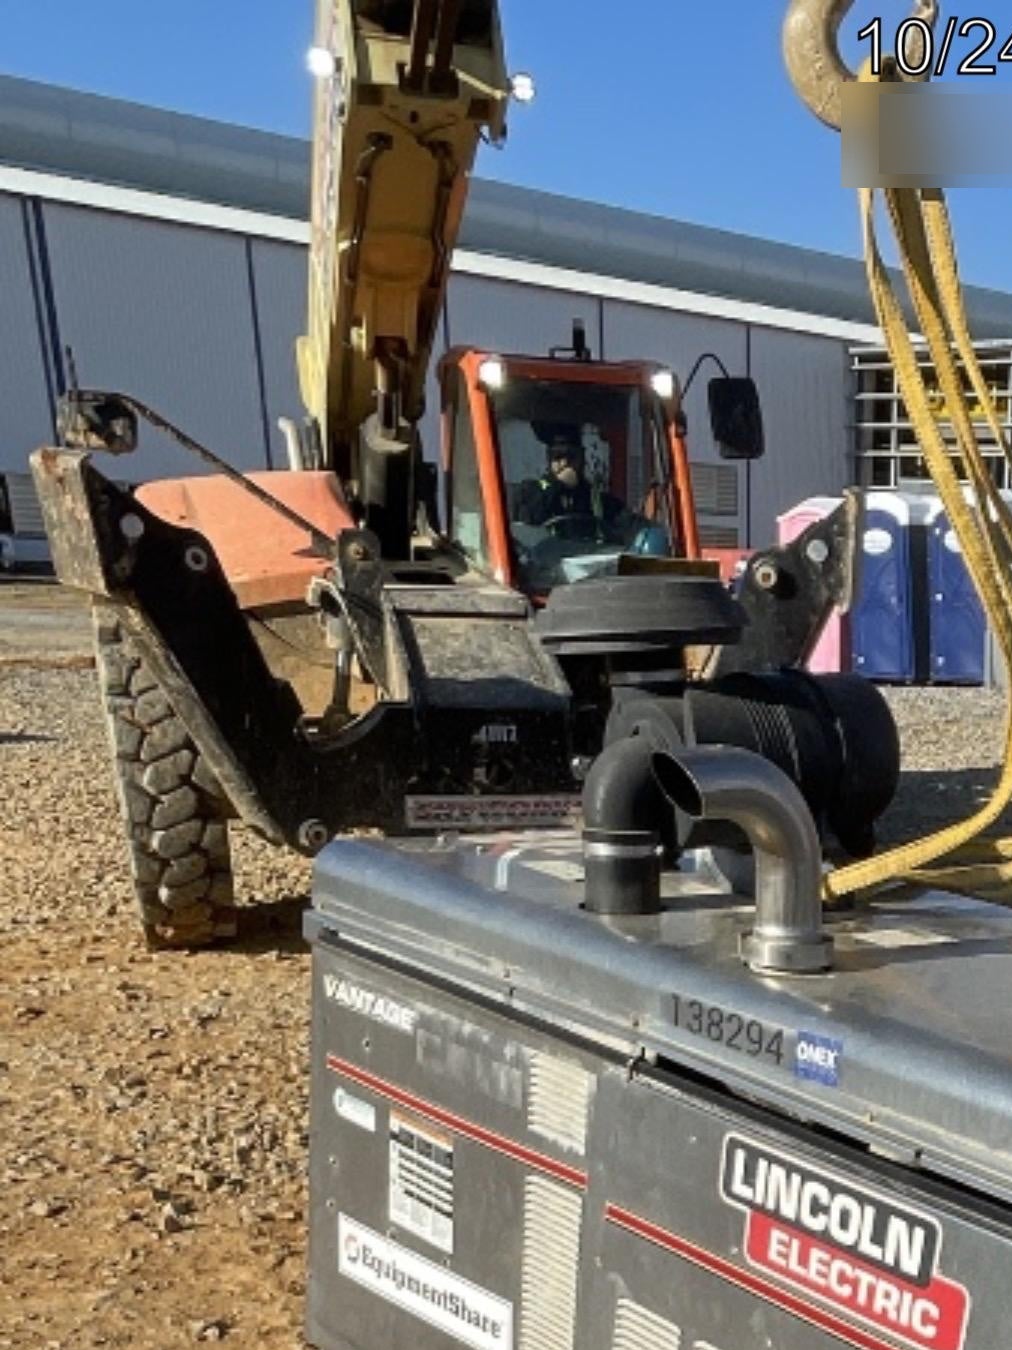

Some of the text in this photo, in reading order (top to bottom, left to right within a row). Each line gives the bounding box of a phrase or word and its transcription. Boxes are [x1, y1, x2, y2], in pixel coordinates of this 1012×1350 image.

[323, 973, 418, 1035] VANTAGE
[731, 1148, 925, 1277] LINCOLN
[361, 1243, 502, 1340] EquipmentShare
[768, 1229, 940, 1339] ELECTRIC
